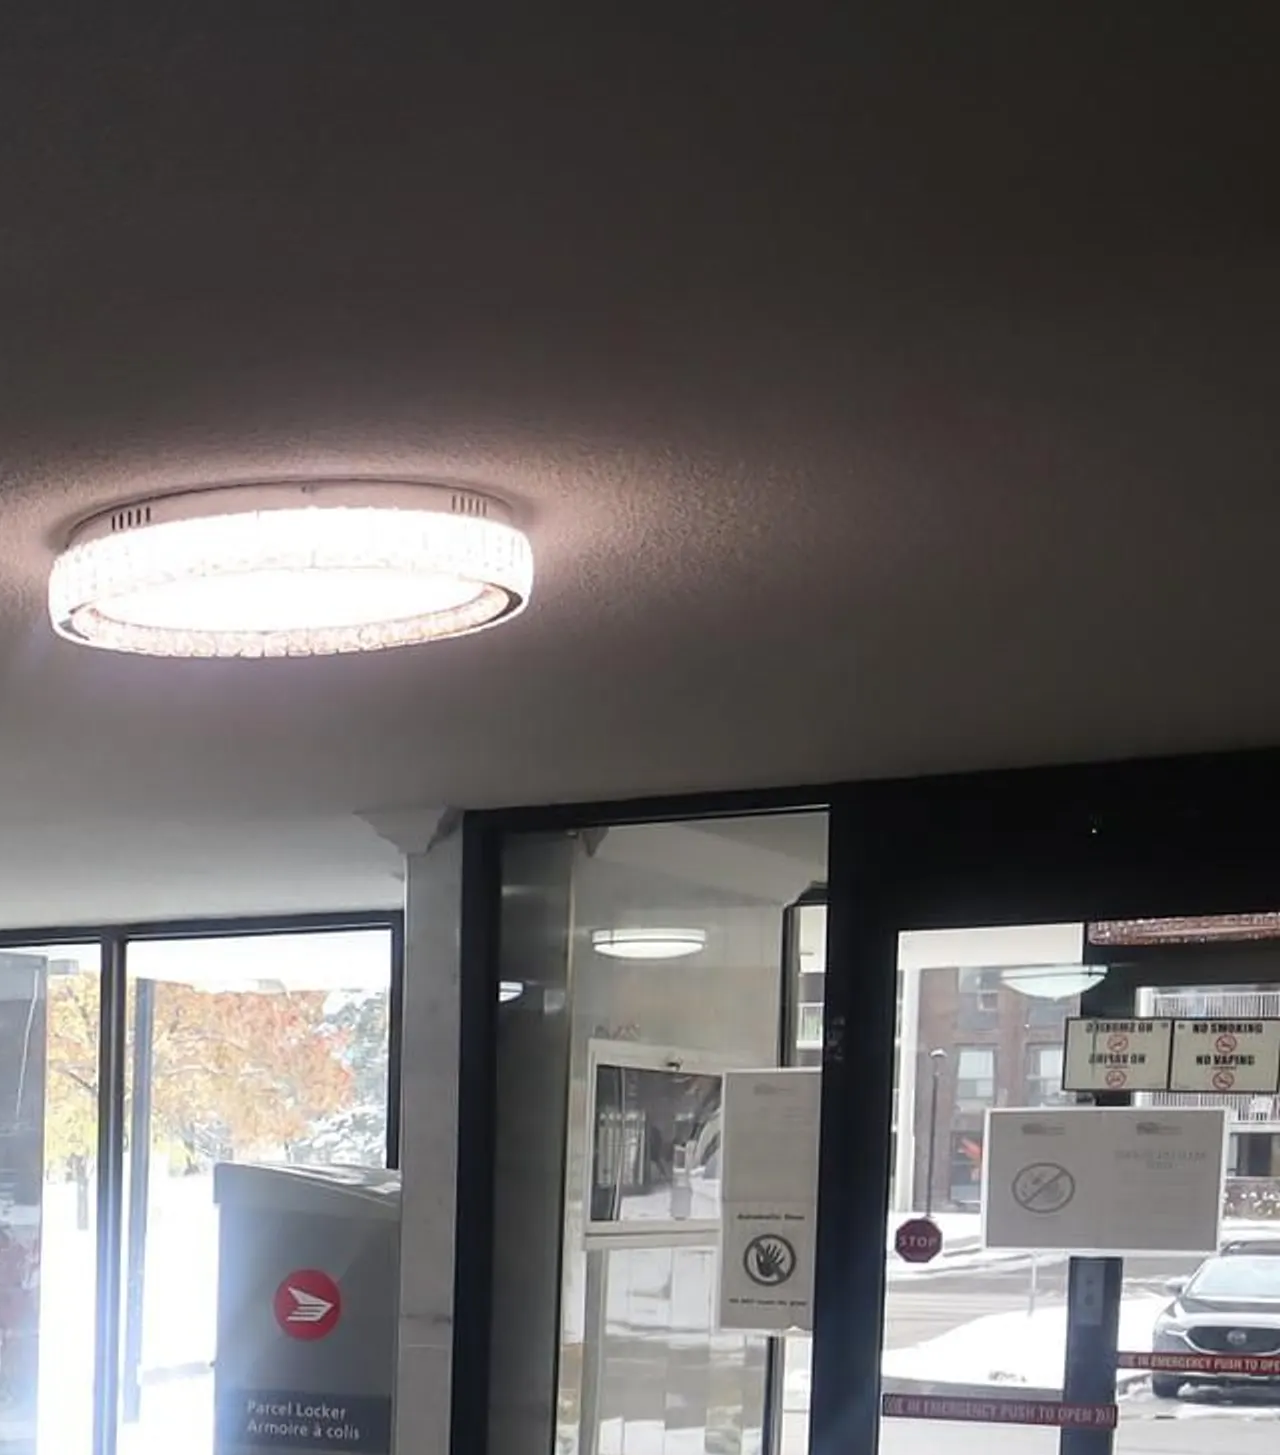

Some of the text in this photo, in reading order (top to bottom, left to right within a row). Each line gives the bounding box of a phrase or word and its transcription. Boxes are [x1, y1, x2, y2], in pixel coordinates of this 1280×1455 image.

[1192, 1023, 1264, 1034] NO SMOKING
[1196, 1054, 1256, 1066] NO VAPING
[898, 1235, 938, 1248] STOP
[1137, 1354, 1148, 1367] IN
[1151, 1354, 1211, 1369] EMERGENCY
[1214, 1356, 1241, 1370] PUSH
[1245, 1357, 1258, 1370] TO
[247, 1399, 346, 1420] Parcel Locker
[1000, 1403, 1036, 1420] PUSH
[1039, 1406, 1055, 1420] TO
[1058, 1407, 1091, 1423] OPEN
[246, 1419, 360, 1441] Armoire à colis
